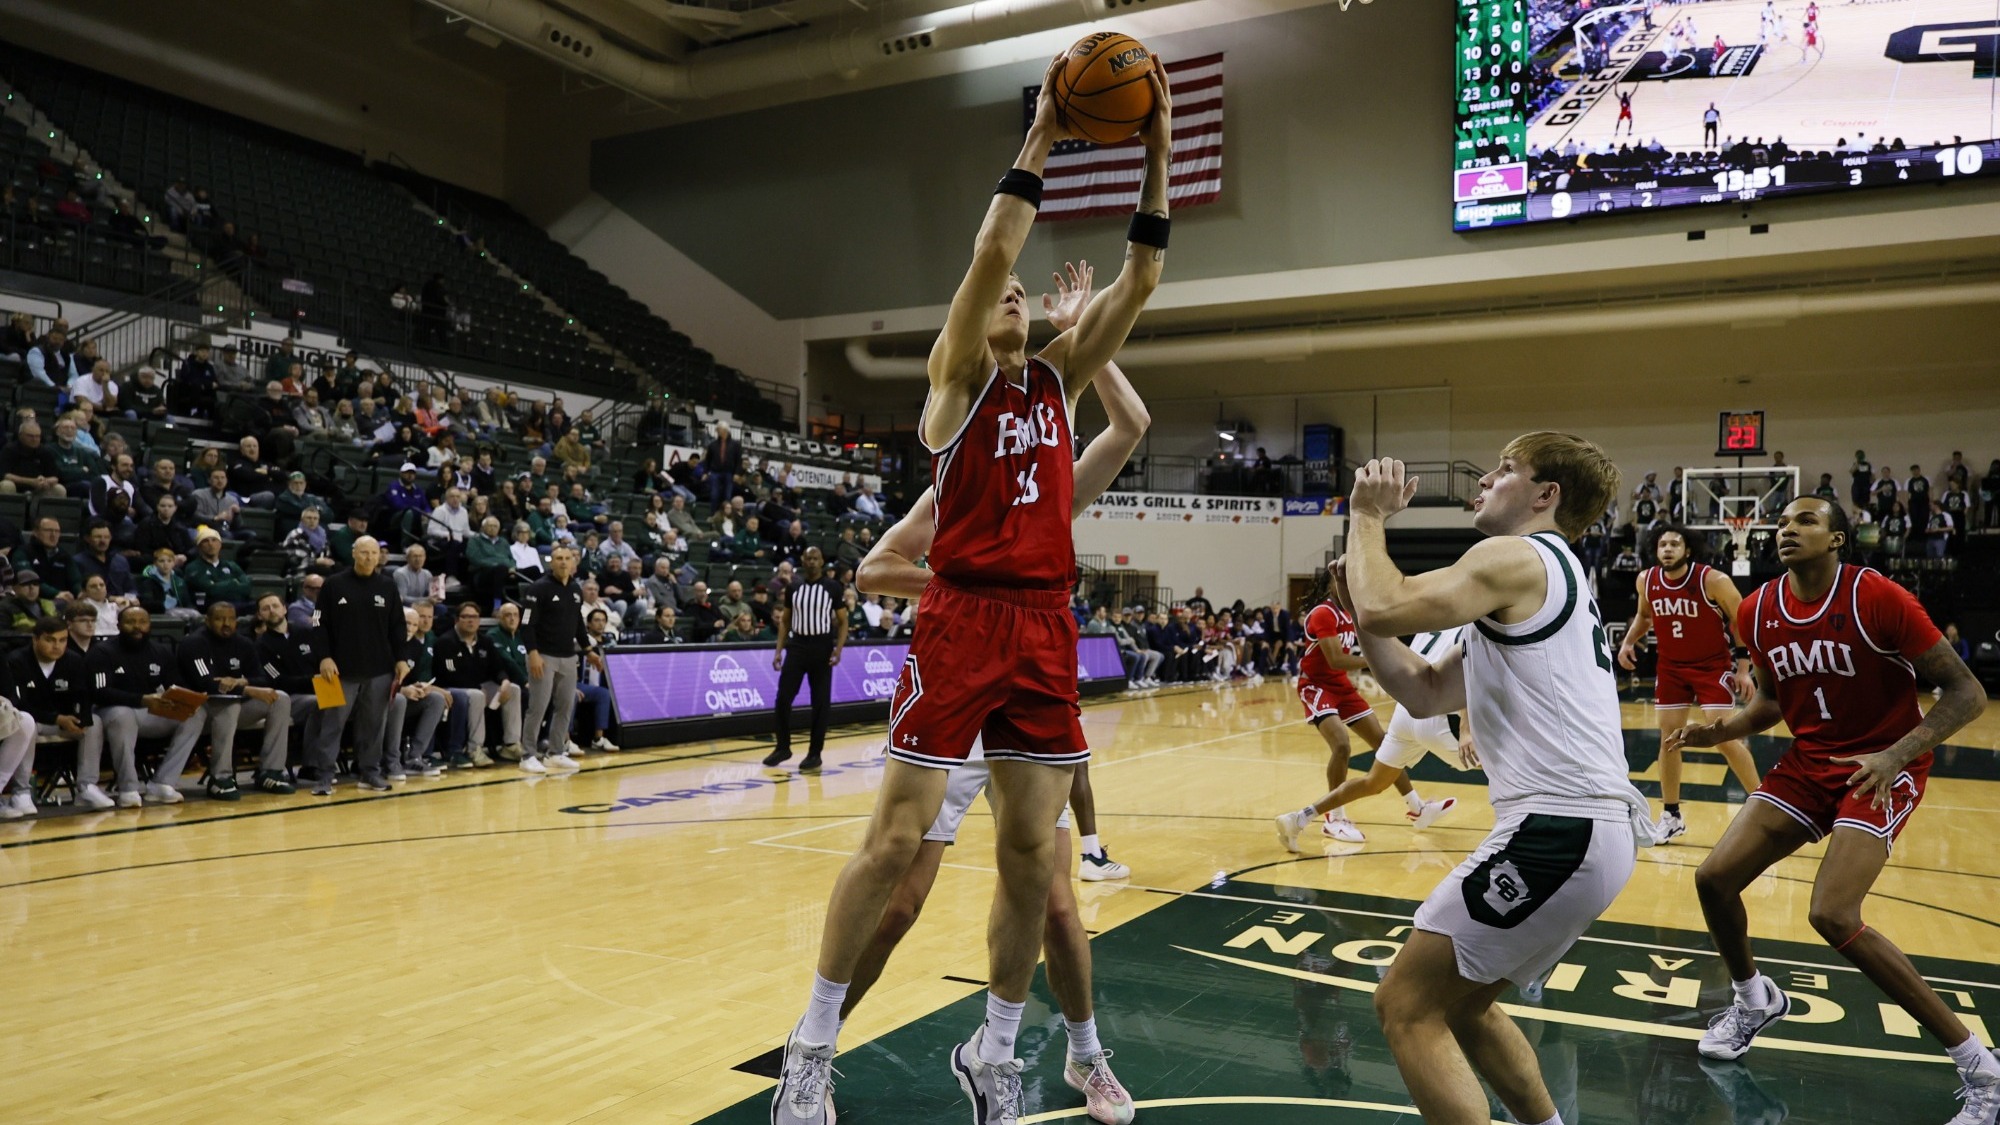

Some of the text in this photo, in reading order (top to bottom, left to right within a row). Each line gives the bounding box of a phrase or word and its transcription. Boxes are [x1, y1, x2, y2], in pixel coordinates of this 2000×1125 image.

[1468, 0, 1521, 21] 2 2 1
[1468, 20, 1522, 41] 7 5 0
[1463, 39, 1521, 60] 10 0 0
[1463, 60, 1521, 80] 13 0 0
[1462, 81, 1521, 101] 23 0 0
[1469, 98, 1514, 113] TEAM STATS
[1513, 133, 1520, 142] 2
[1843, 156, 1868, 167] FOULS
[1934, 145, 1983, 176] 10
[1635, 180, 1658, 190] FOULS
[1712, 165, 1786, 193] 13:51
[1850, 169, 1909, 186] 3 4
[1470, 183, 1510, 196] ONEIDA
[1738, 189, 1758, 200] 1ST
[1551, 192, 1573, 218] 9
[1601, 202, 1610, 212] 4
[1641, 193, 1653, 207] 2
[1457, 202, 1522, 219] PHOENIX
[1726, 426, 1757, 449] 23
[1143, 496, 1187, 509] GRILL
[1191, 498, 1201, 509] &
[1206, 498, 1262, 512] SPIRITS
[1651, 597, 1698, 618] RMU
[1671, 620, 1684, 639] 2
[1767, 639, 1857, 683] RMU
[705, 687, 765, 711] ONEIDA
[1813, 686, 1833, 720] 1
[1494, 873, 1520, 903] GB
